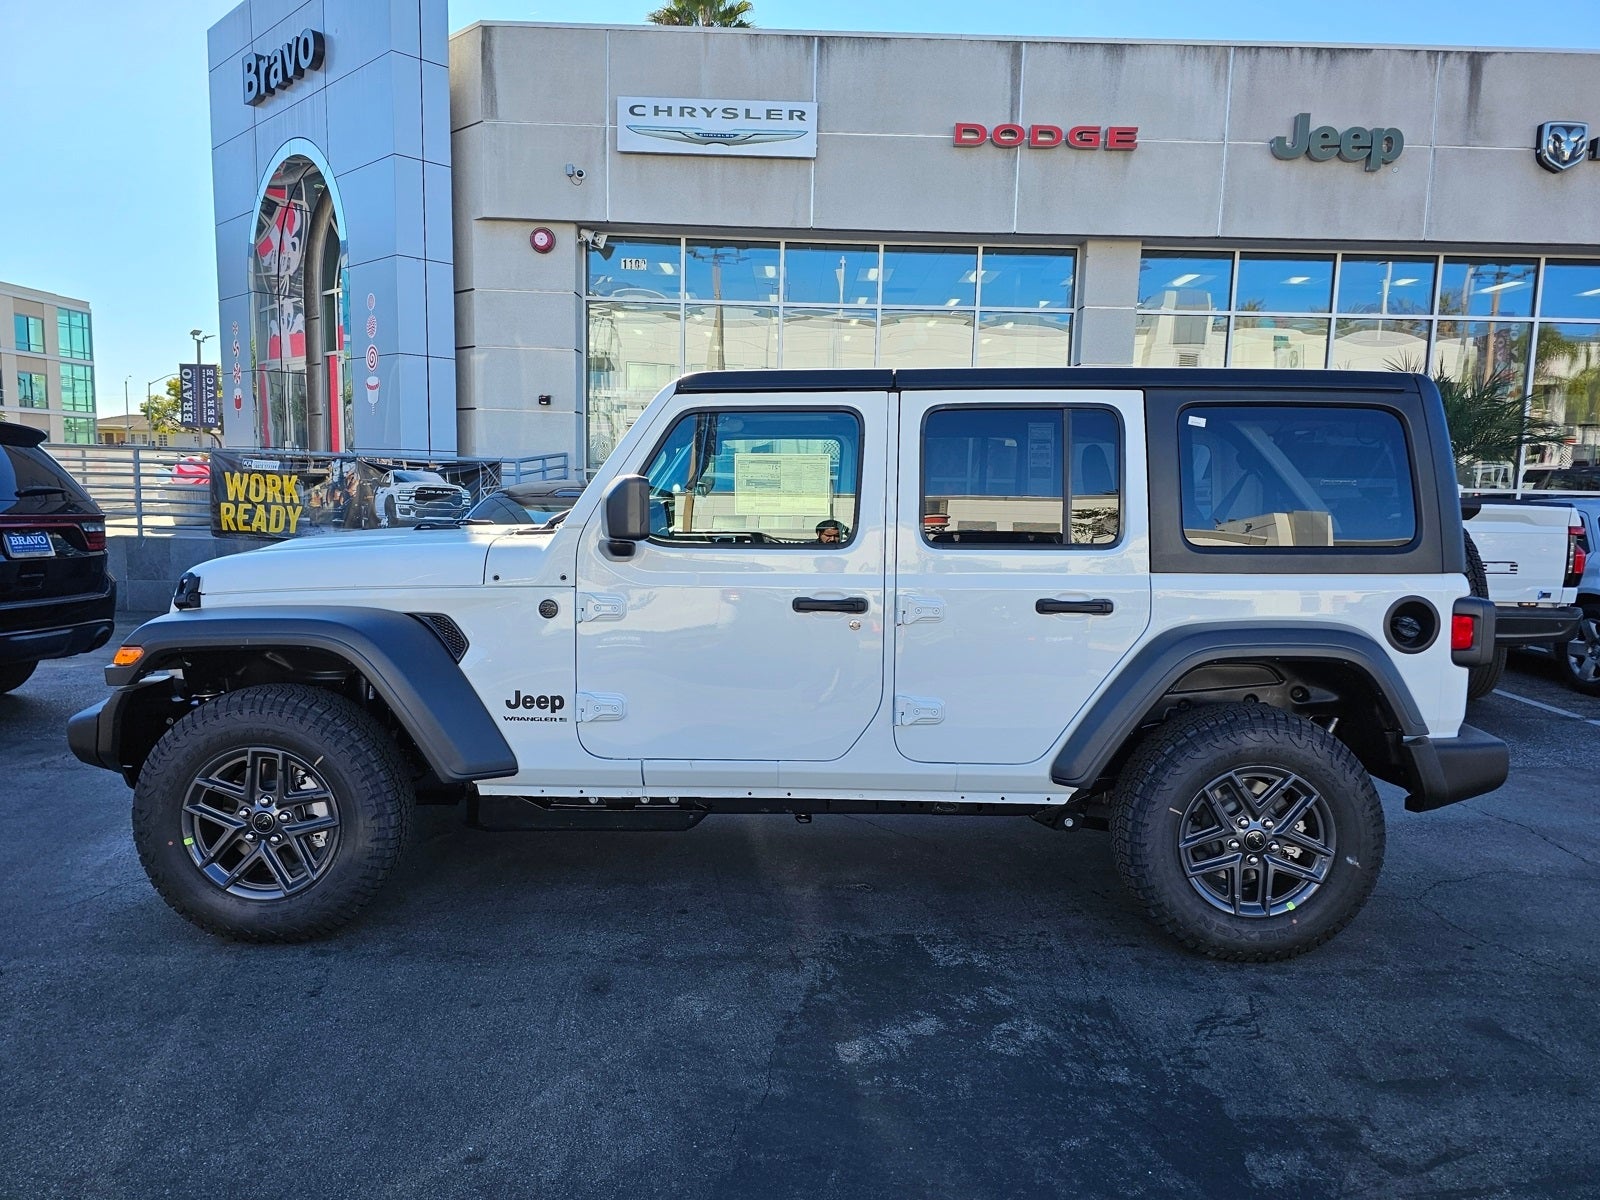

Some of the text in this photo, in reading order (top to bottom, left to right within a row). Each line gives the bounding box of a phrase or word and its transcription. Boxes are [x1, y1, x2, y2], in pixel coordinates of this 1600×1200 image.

[242, 28, 325, 106] Bravo
[628, 104, 807, 122] CHRYSLER
[953, 122, 1139, 150] DODGE
[1270, 113, 1405, 172] Jeep
[181, 368, 193, 423] BRAVO
[206, 368, 215, 424] SERVICE
[224, 471, 300, 504] WORK
[220, 502, 303, 534] READY
[9, 535, 47, 546] BRAVO
[505, 690, 565, 713] Jeep
